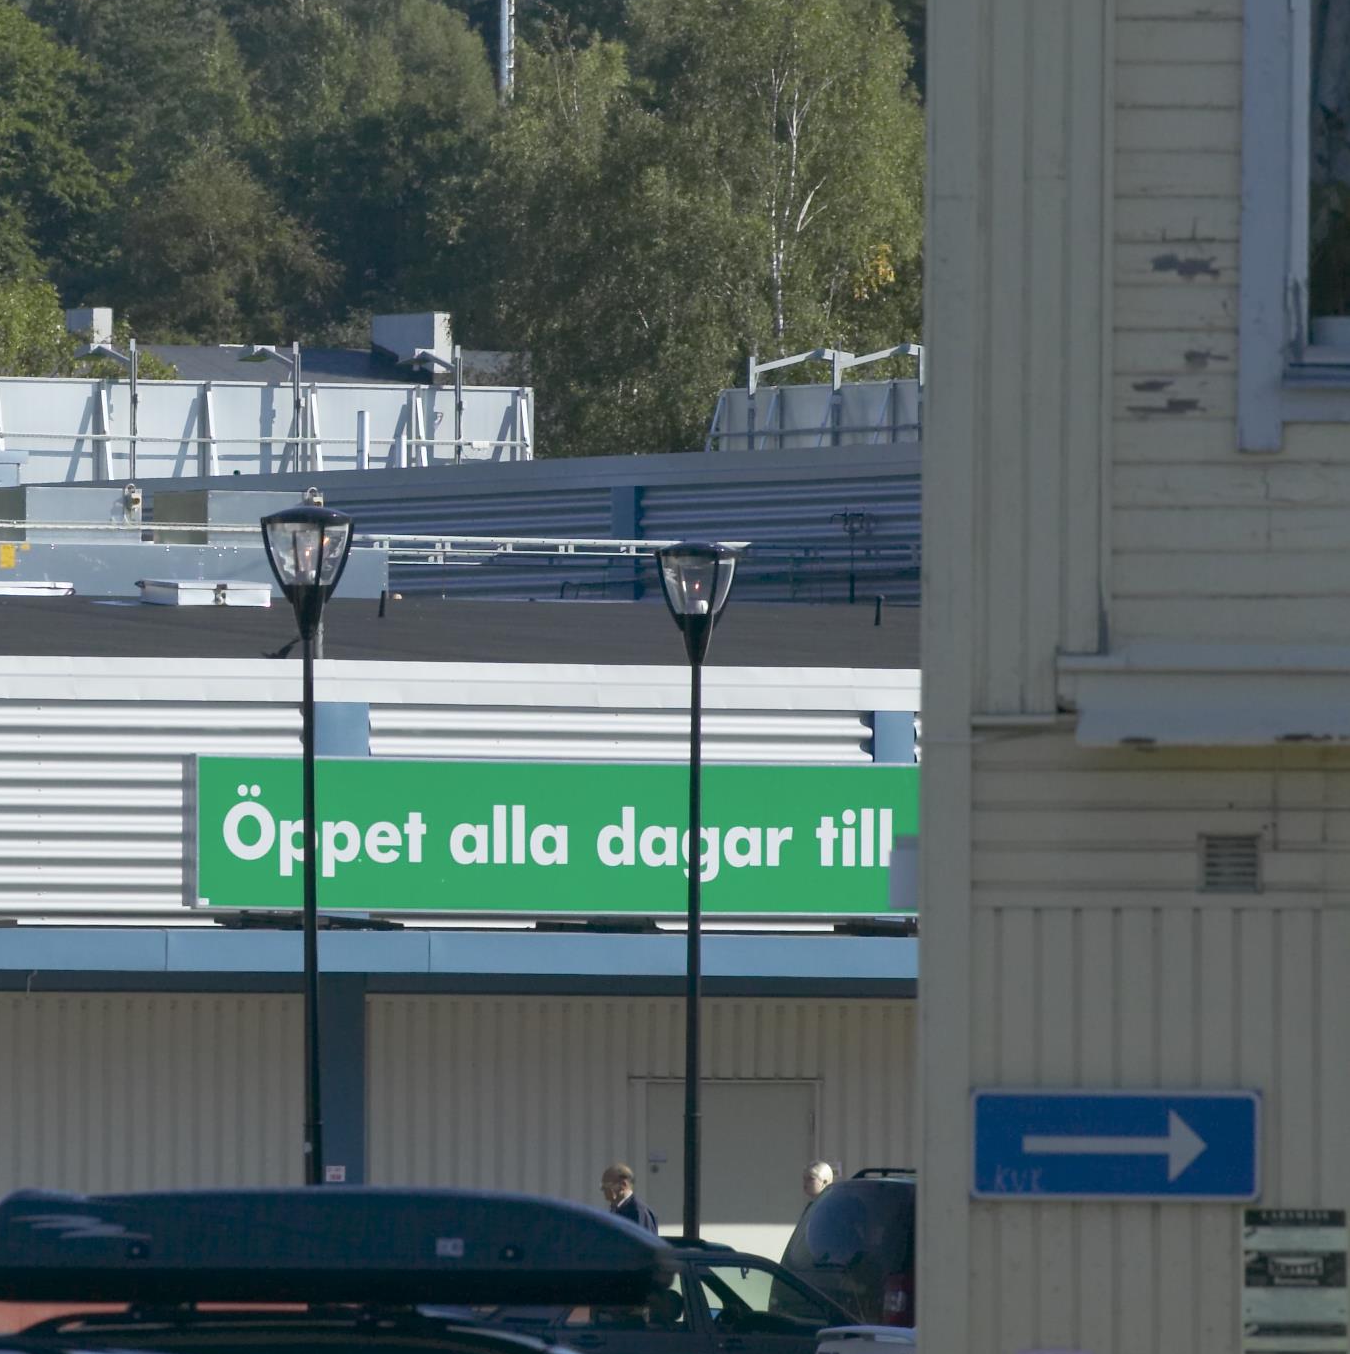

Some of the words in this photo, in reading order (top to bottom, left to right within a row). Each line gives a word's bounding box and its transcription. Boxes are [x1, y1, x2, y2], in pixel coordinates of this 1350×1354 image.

[222, 784, 427, 878] Öppet
[449, 804, 568, 866] alla
[596, 806, 793, 884] dagar
[815, 808, 893, 867] till
